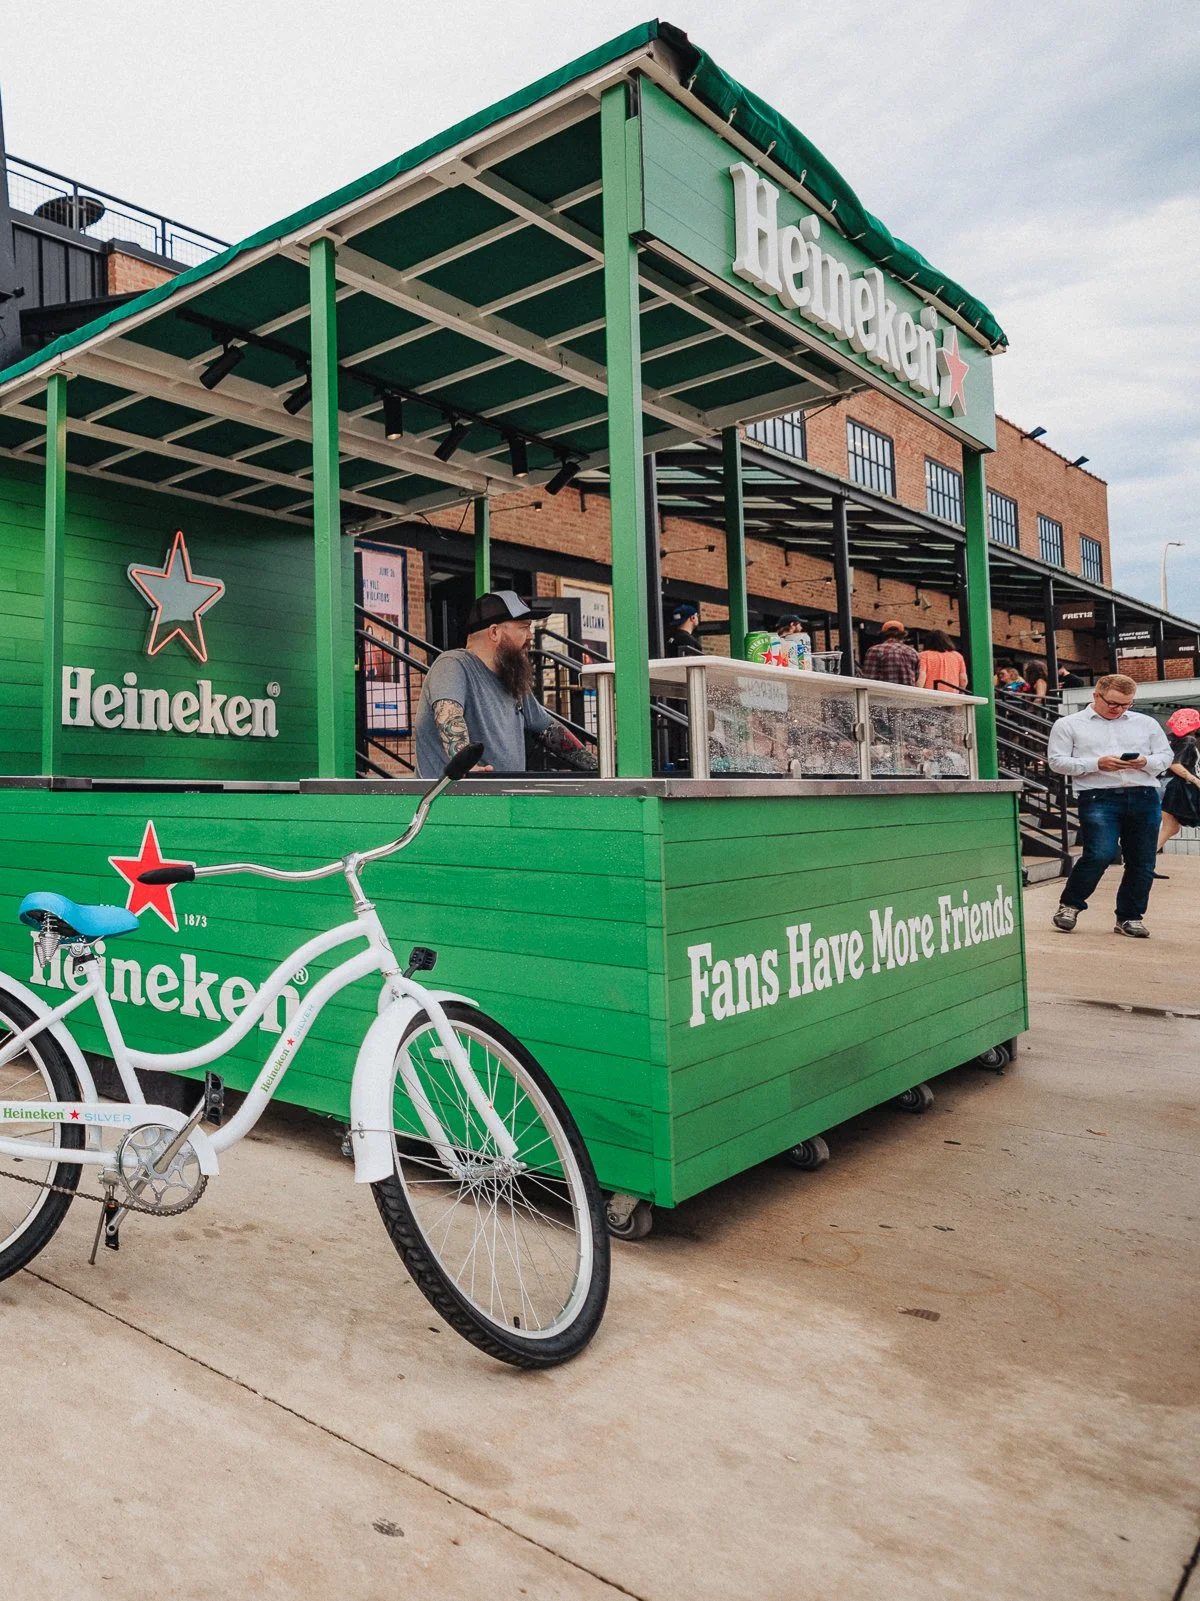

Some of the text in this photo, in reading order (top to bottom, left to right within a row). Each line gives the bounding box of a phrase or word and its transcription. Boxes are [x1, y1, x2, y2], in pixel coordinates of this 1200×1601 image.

[184, 913, 207, 927] 1873
[687, 884, 1014, 1027] Fans Have More Friends
[260, 1004, 315, 1092] Heineken SILVER
[84, 1112, 132, 1121] SILVER
